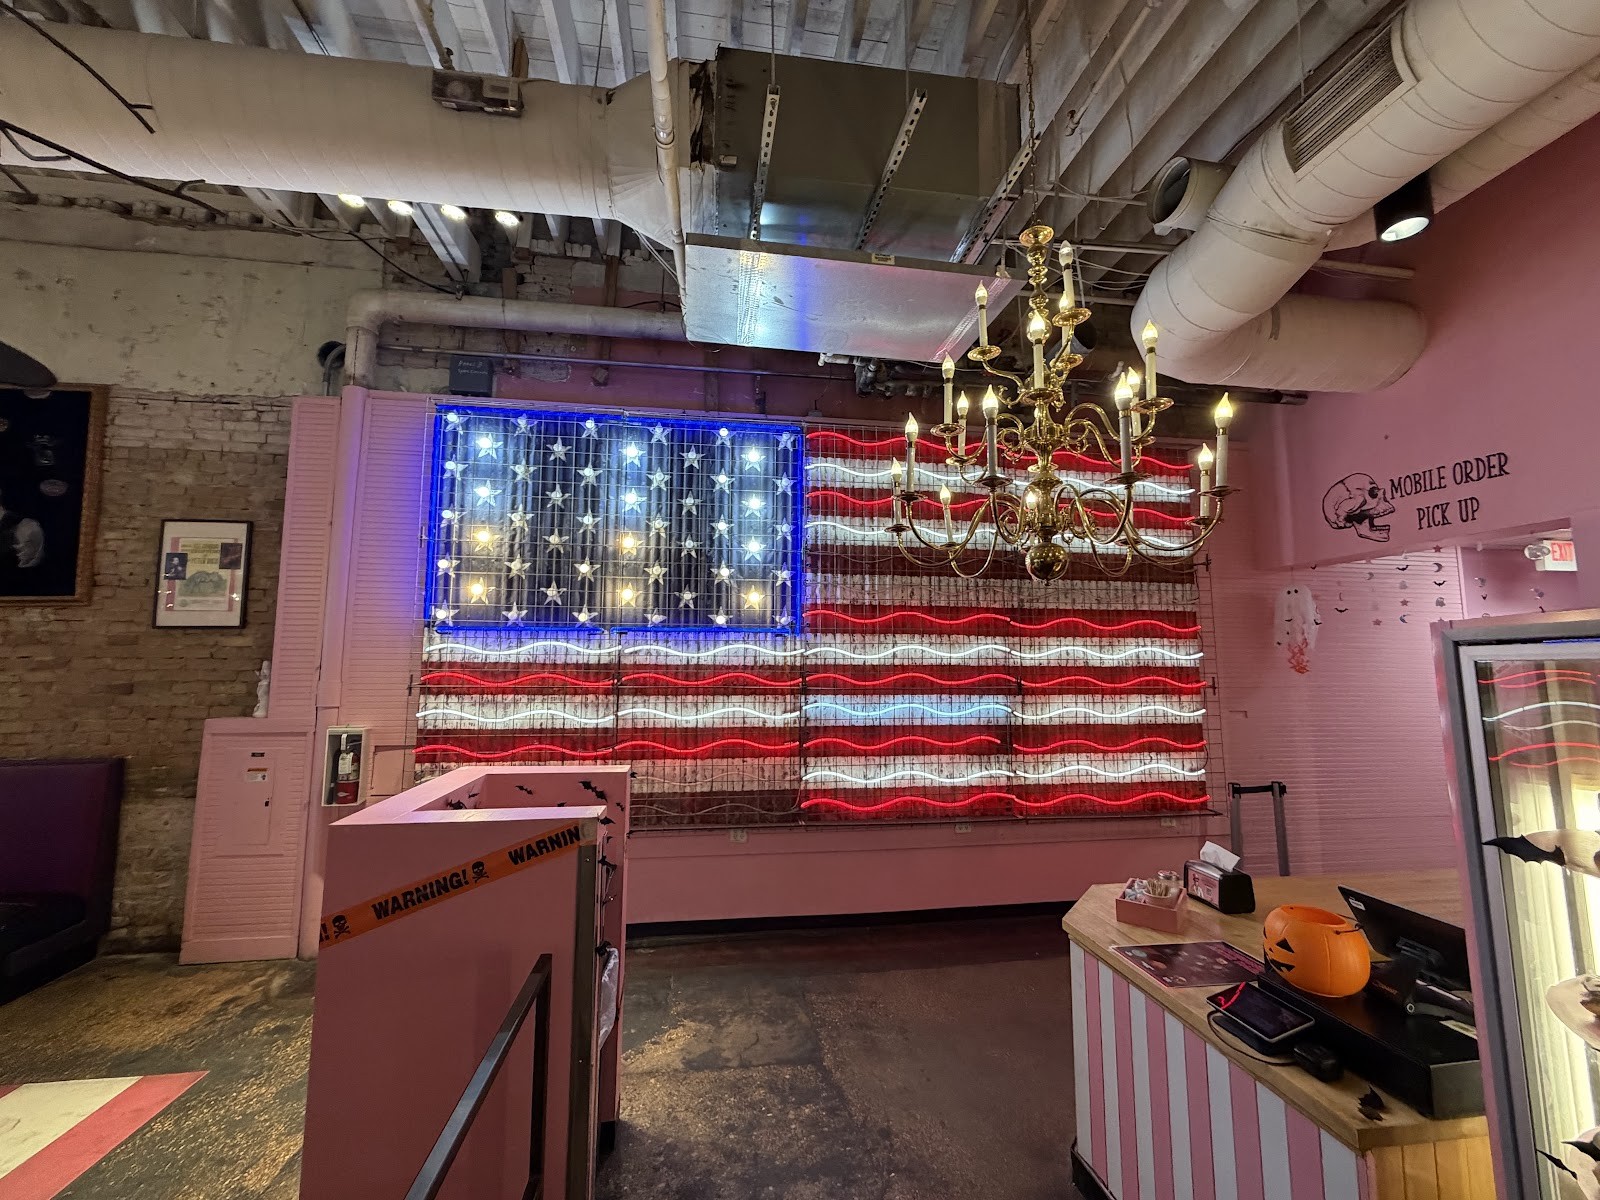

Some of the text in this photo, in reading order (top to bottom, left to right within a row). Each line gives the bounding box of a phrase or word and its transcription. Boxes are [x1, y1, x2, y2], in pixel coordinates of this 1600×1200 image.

[1389, 452, 1511, 500] MOBILE ORDER
[1416, 496, 1480, 531] PICK UP
[1551, 542, 1573, 561] EXIT
[371, 869, 470, 920] WARNING!
